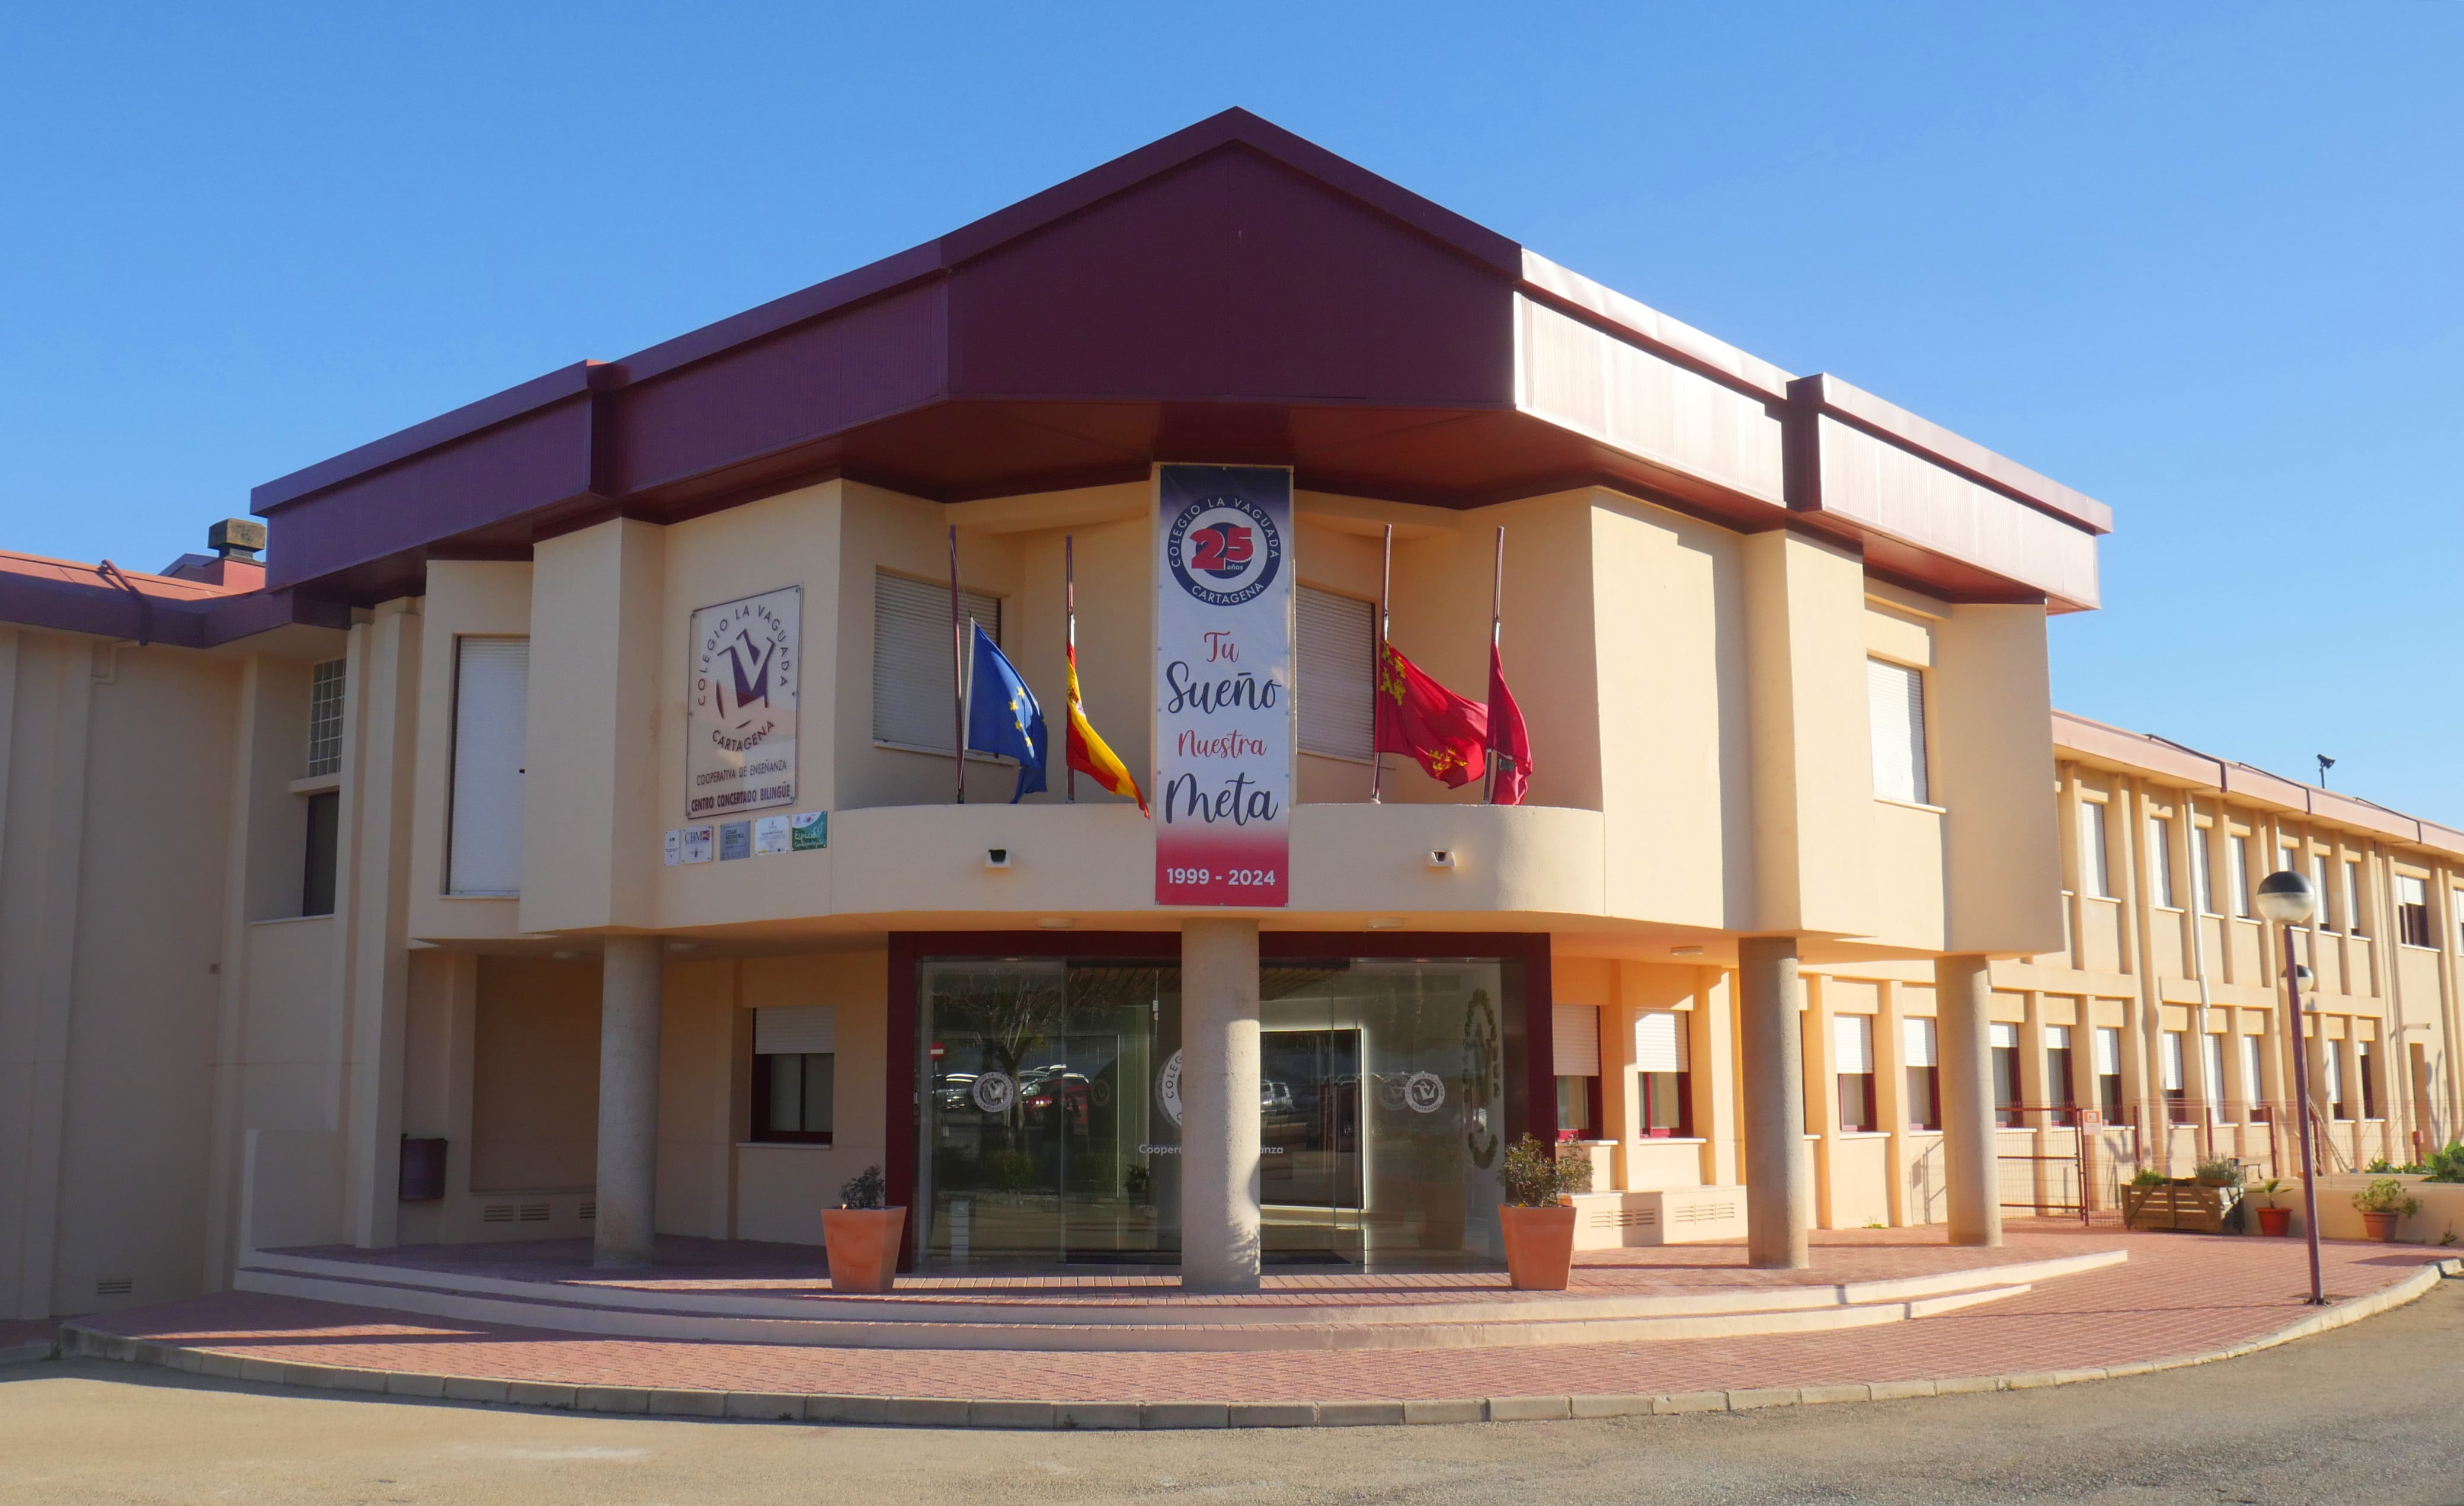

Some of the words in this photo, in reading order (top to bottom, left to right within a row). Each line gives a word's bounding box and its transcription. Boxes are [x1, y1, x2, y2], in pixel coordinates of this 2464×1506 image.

[1170, 505, 1201, 567] COLEGIO
[1208, 498, 1225, 508] LA
[1234, 498, 1279, 558] VAGUADA
[1189, 527, 1254, 570] 25
[1192, 583, 1264, 604] CARTAGENA
[698, 619, 728, 706] COLEGIO
[735, 605, 750, 620] LA
[758, 604, 789, 687] VAGUADA
[1204, 631, 1239, 662] Tu
[1166, 661, 1282, 714] Sueño
[712, 720, 775, 752] CARTAGENA
[1178, 729, 1267, 758] Nuestra
[696, 769, 735, 786] COOPERATIVA
[739, 767, 747, 778] DE
[750, 759, 786, 776] ENSEÑANZA
[691, 797, 714, 812] CENTRO
[717, 790, 757, 808] CONCERTADO
[760, 781, 790, 801] BILINGÜE
[1165, 772, 1279, 826] Meta
[684, 831, 703, 843] CBM
[1167, 868, 1209, 885] 1999
[1228, 869, 1276, 886] 2024
[1166, 1055, 1182, 1099] COLEG
